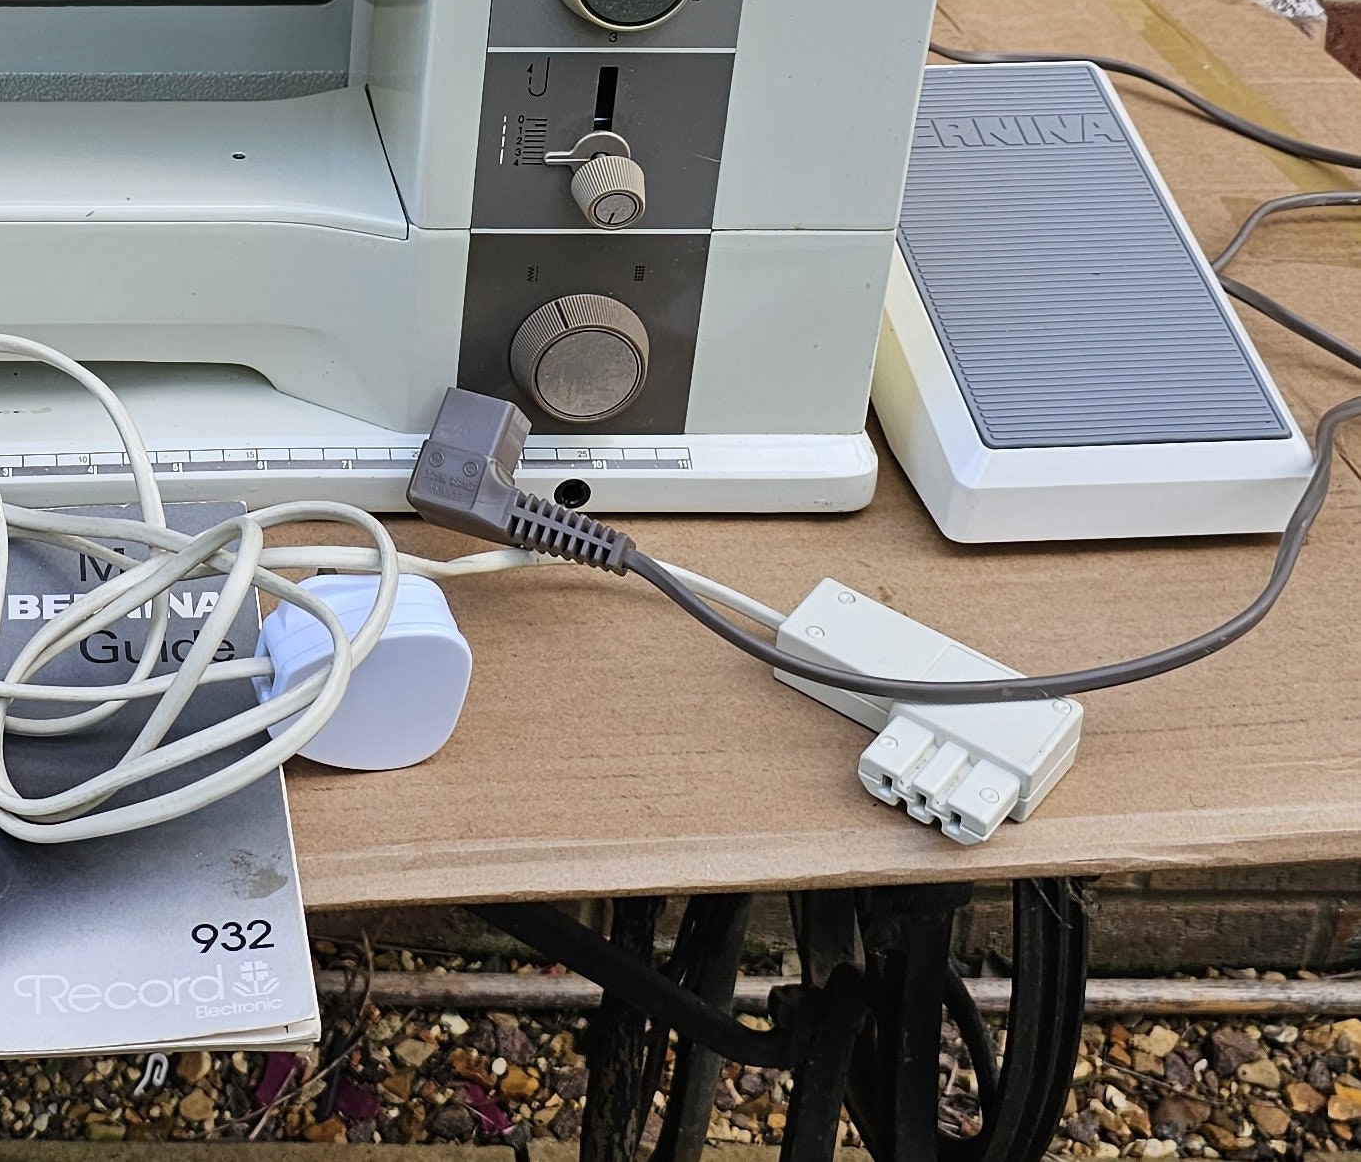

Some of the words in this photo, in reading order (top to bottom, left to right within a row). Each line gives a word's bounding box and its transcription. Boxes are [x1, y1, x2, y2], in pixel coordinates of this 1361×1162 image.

[608, 32, 618, 43] 3
[518, 115, 525, 123] 0
[910, 113, 1126, 149] ERNINA
[516, 137, 523, 145] 2
[515, 148, 521, 156] 3
[78, 455, 88, 464] 10
[245, 451, 255, 459] 15
[577, 450, 588, 458] 25
[2, 467, 9, 477] 3
[88, 465, 94, 475] 4
[172, 462, 179, 472] 5
[257, 461, 264, 470] 6
[341, 460, 348, 469] 7
[591, 460, 603, 469] 10
[677, 459, 687, 469] 11
[79, 547, 127, 582] M
[7, 591, 222, 620] BEINA
[191, 919, 275, 954] 932
[13, 963, 226, 1016] Record
[195, 996, 284, 1019] Electronic
[283, 1024, 290, 1034] 1
